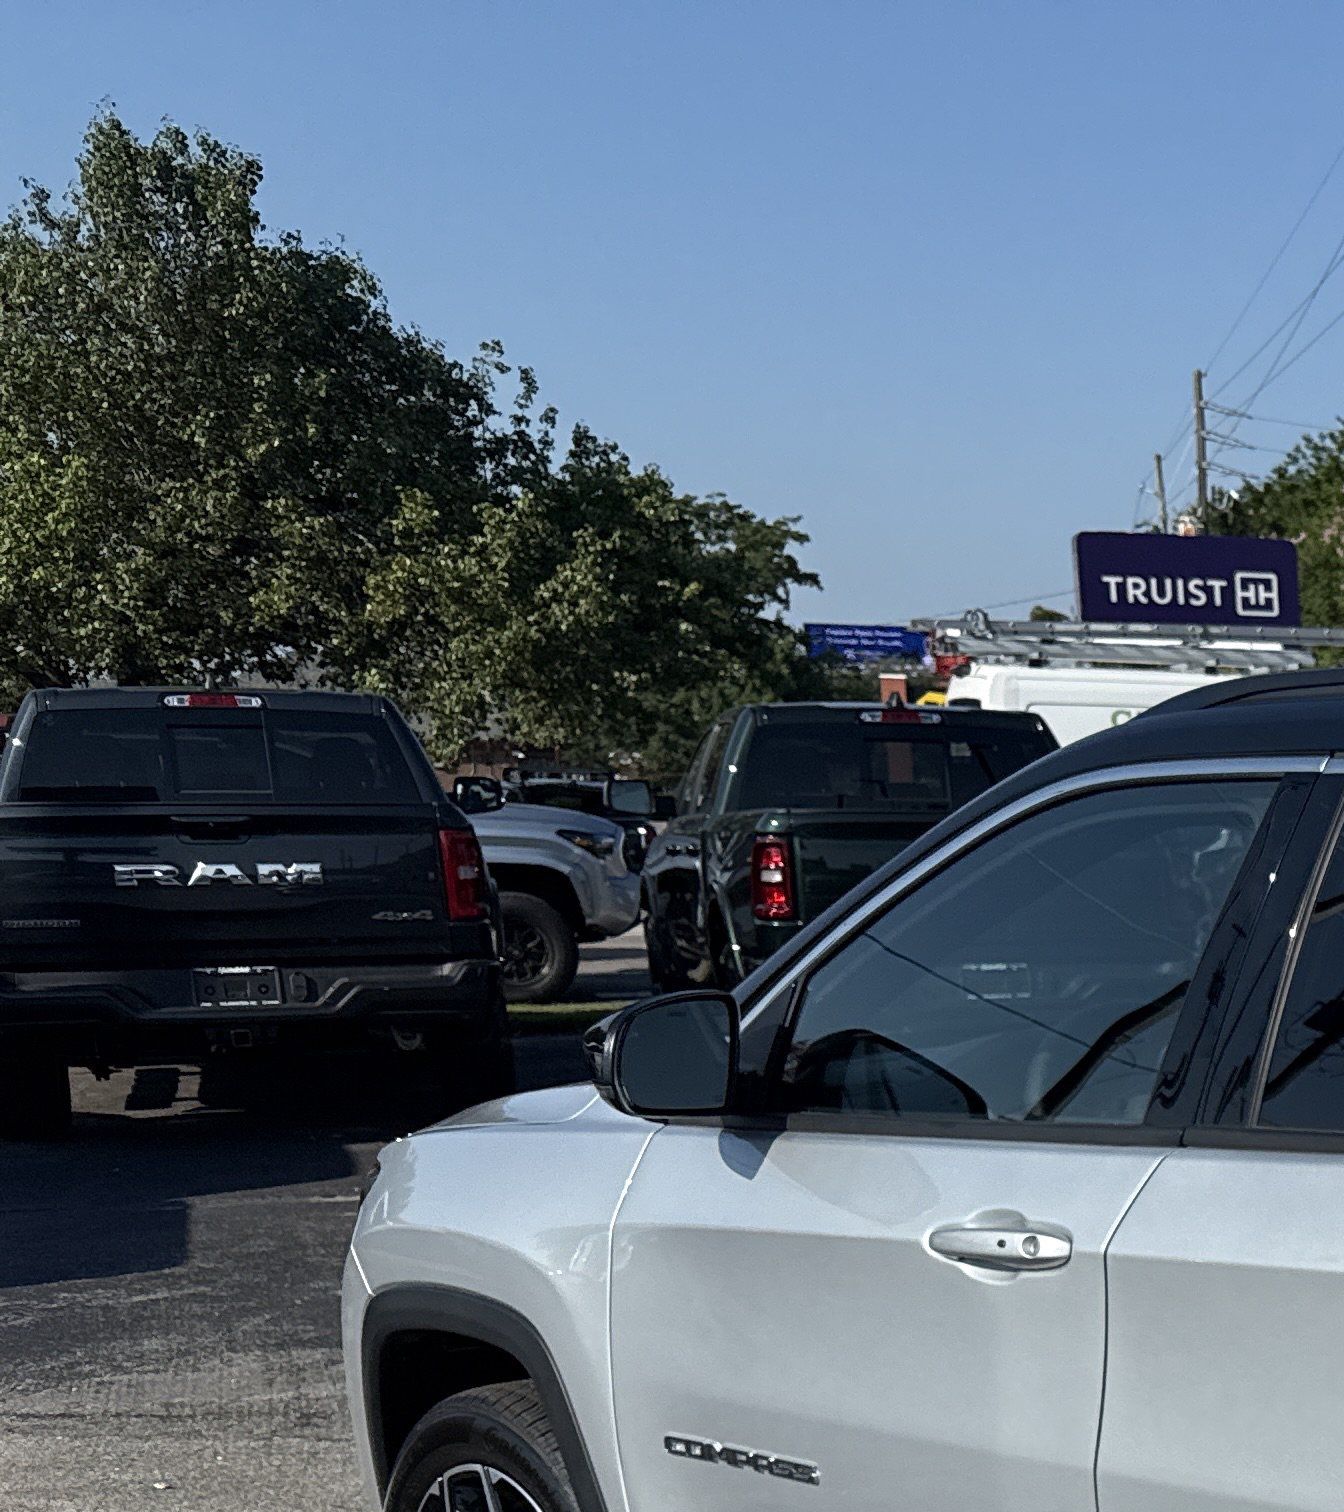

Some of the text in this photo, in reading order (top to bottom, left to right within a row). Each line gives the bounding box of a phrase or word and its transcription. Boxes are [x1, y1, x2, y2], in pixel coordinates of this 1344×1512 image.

[1102, 575, 1228, 607] TRUIST
[112, 861, 323, 886] RAM
[664, 1431, 821, 1486] COMPASS
